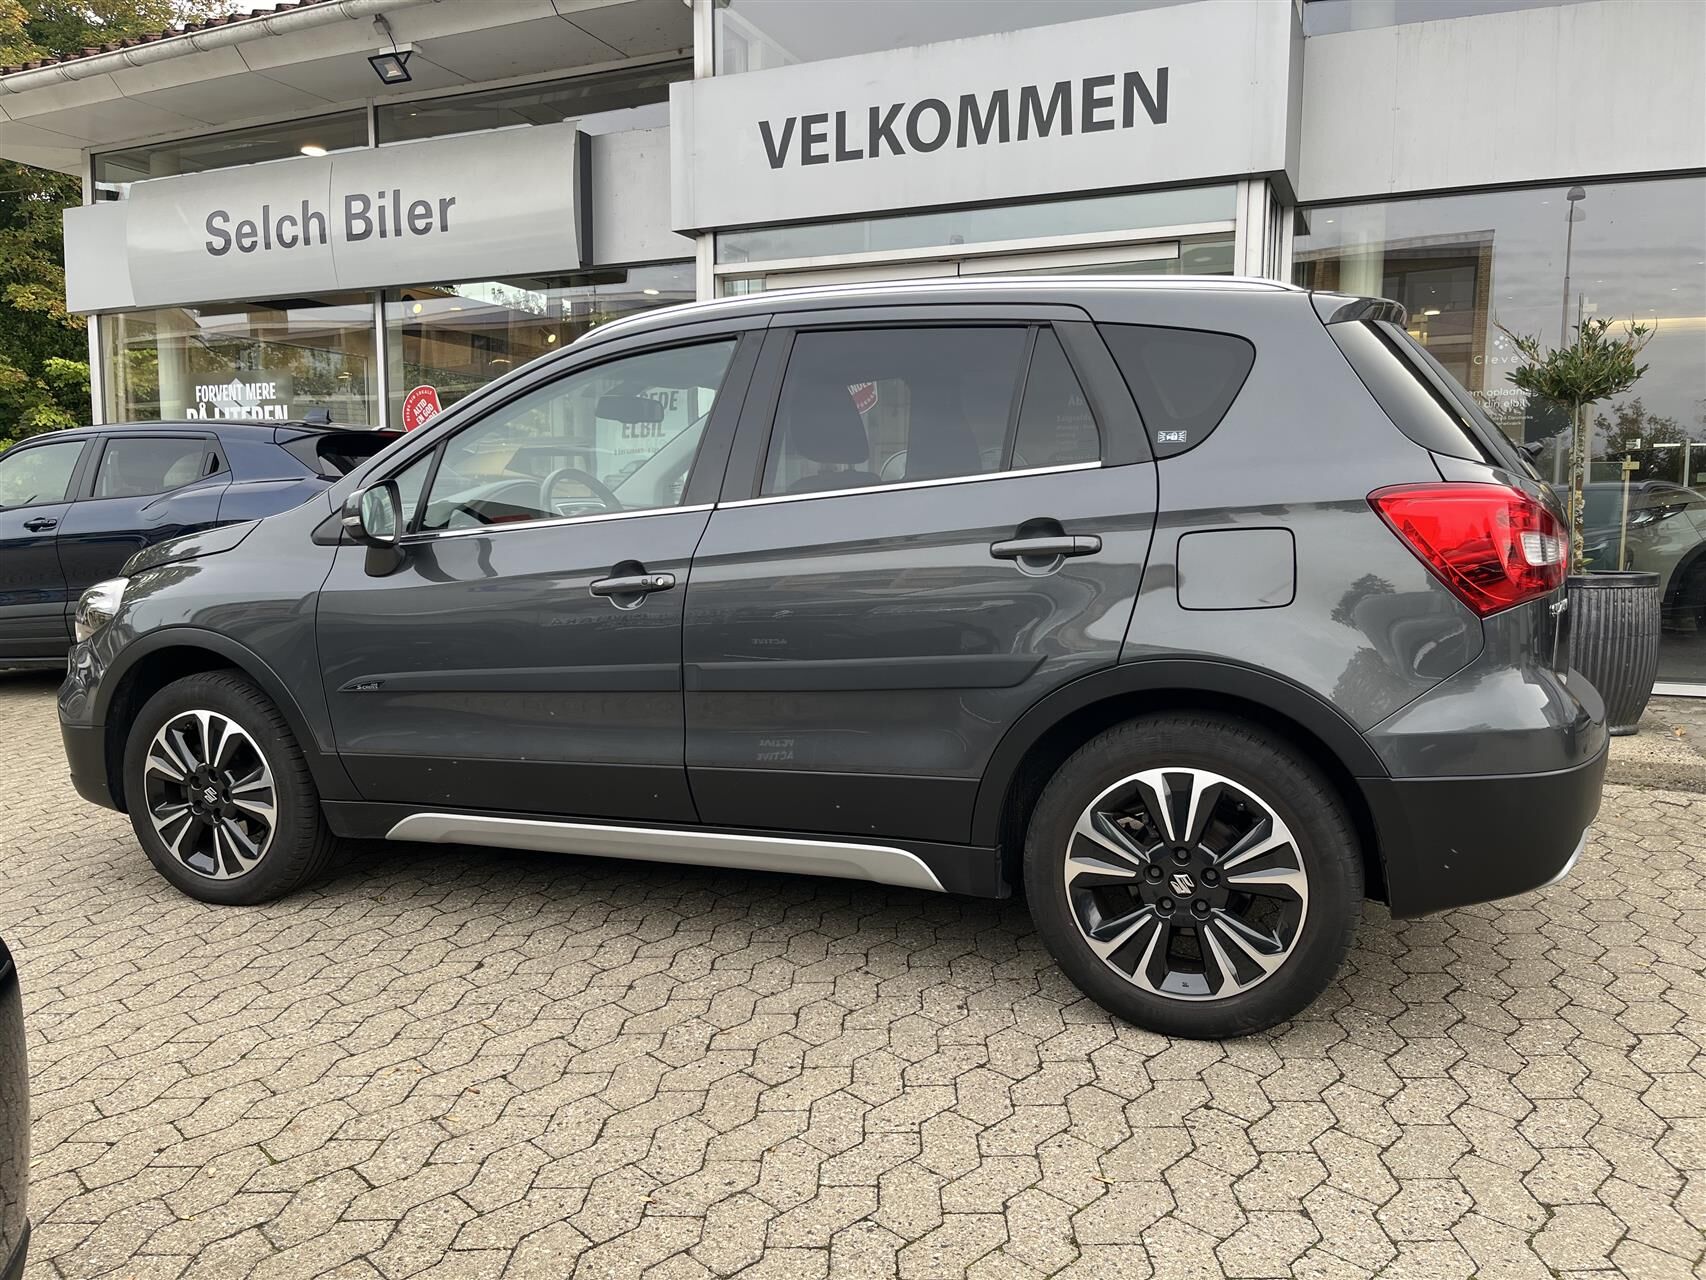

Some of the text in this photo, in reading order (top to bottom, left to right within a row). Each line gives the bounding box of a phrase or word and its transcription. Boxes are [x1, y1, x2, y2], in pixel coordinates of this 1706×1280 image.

[758, 66, 1169, 170] VELKOMMEN
[205, 188, 456, 257] Selch Biler
[195, 382, 277, 402] FORVENT MERE
[414, 399, 427, 416] ALTID
[423, 403, 434, 417] GOD
[621, 421, 666, 439] ELBIL
